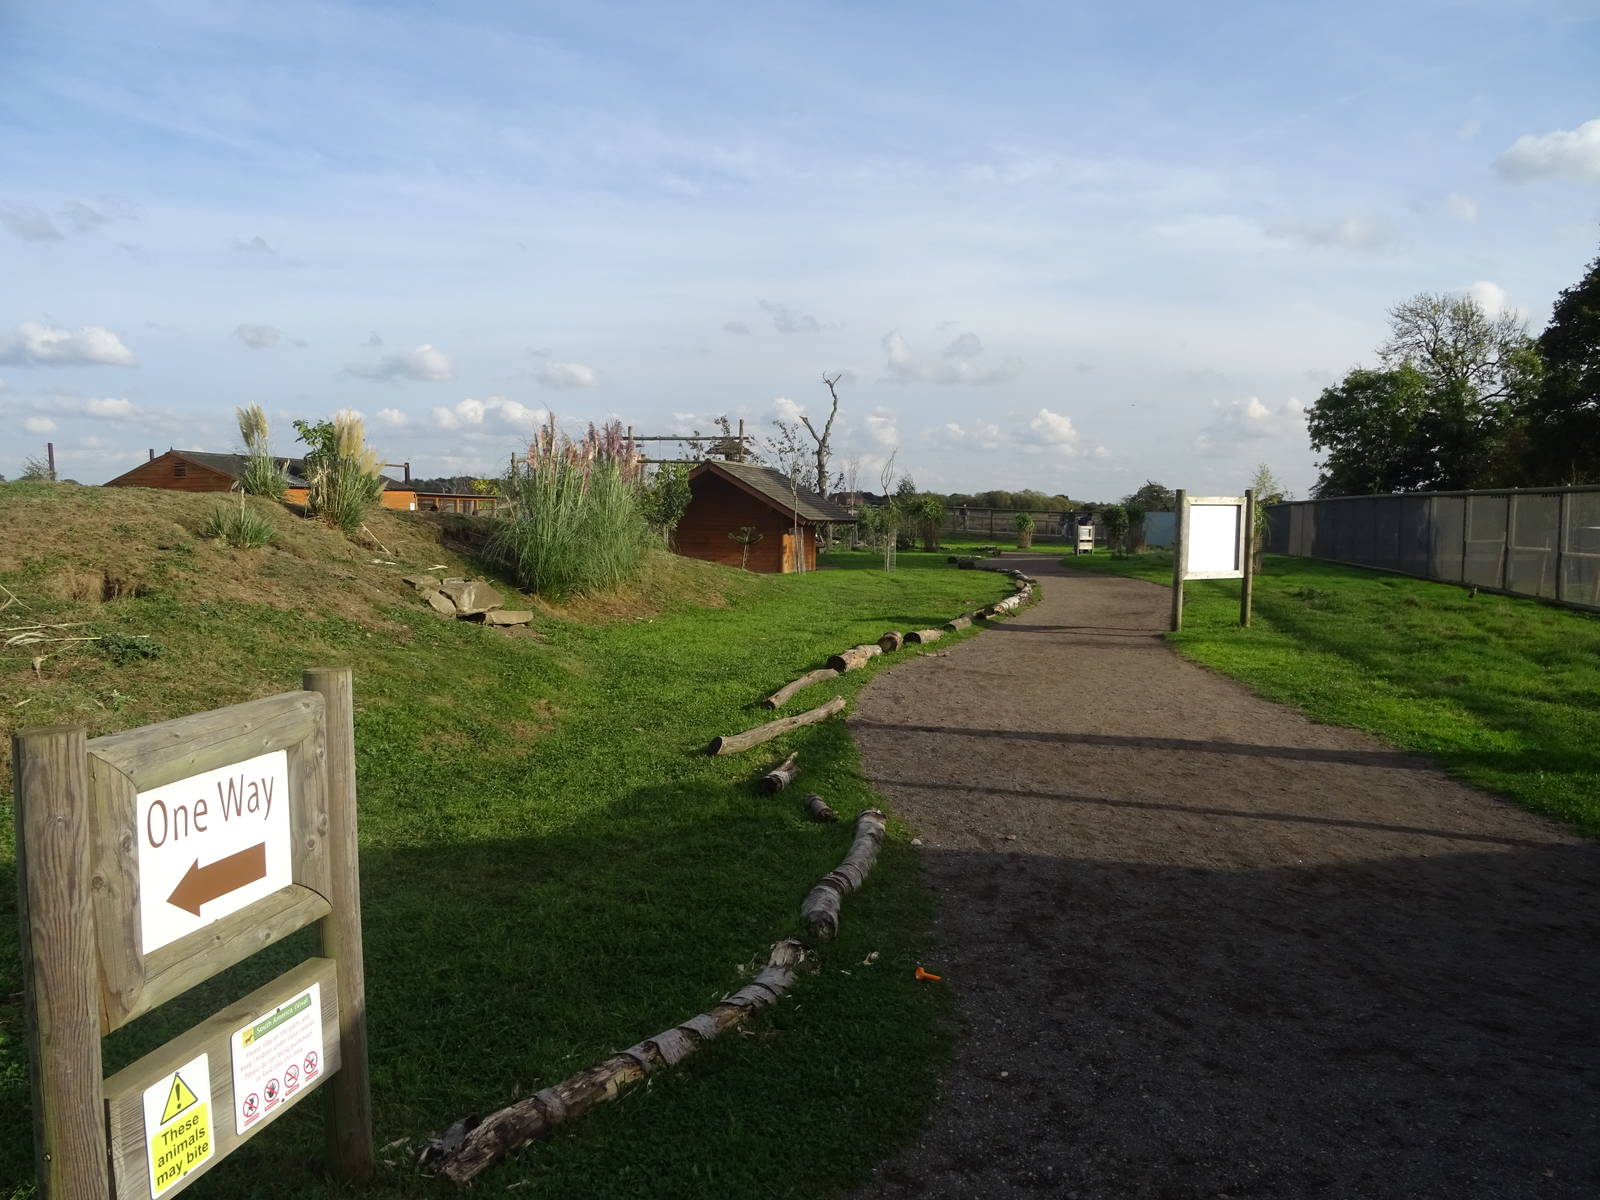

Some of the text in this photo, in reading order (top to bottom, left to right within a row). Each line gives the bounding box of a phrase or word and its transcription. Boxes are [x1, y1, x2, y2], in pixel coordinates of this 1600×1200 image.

[147, 773, 274, 848] One Way
[158, 1127, 206, 1168] animals
[161, 1115, 199, 1146] These
[156, 1142, 209, 1187] may bite
